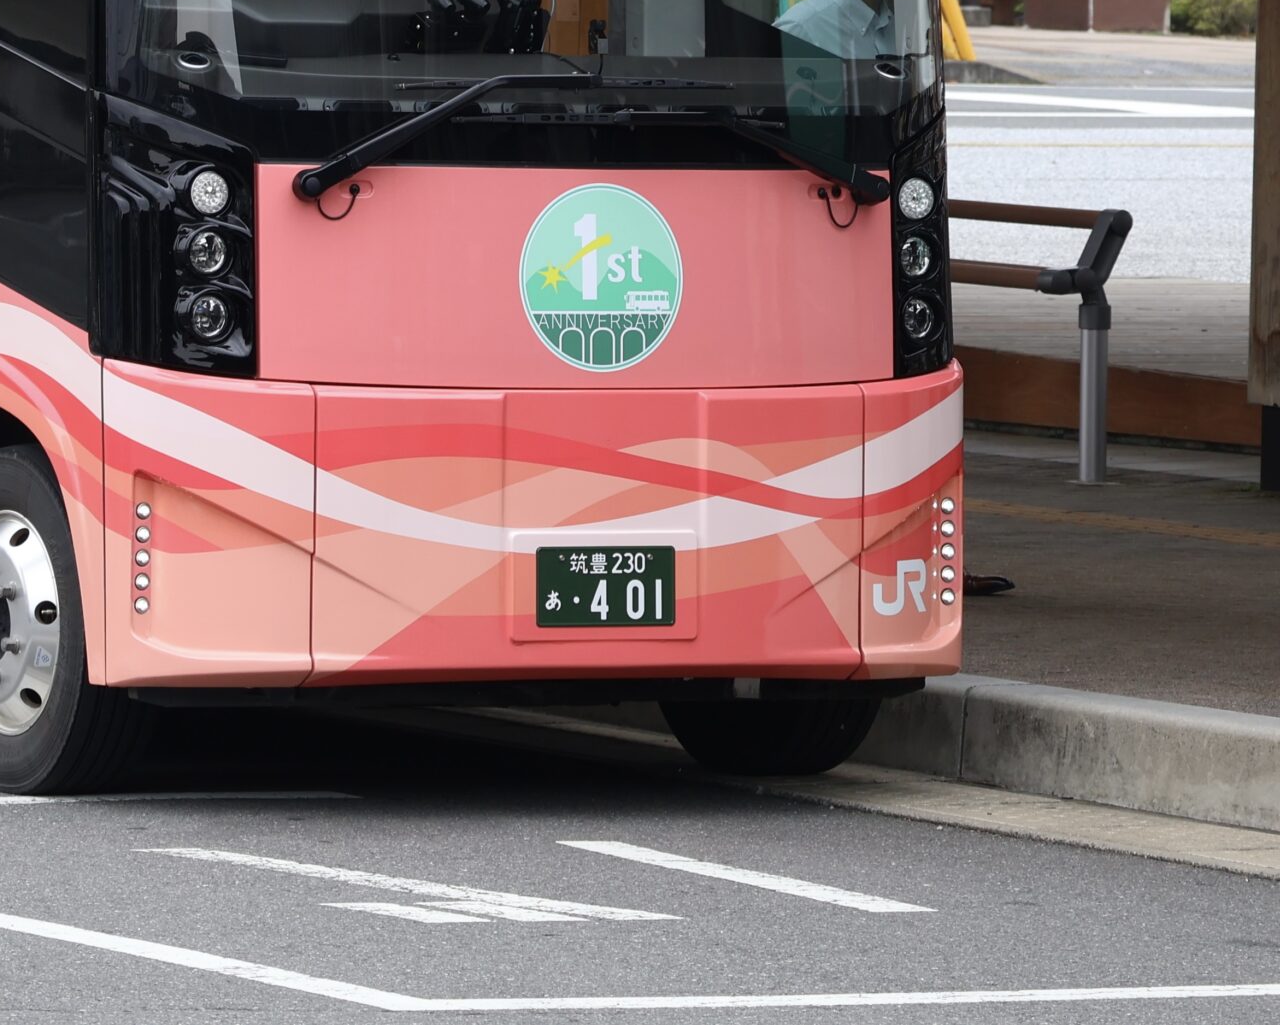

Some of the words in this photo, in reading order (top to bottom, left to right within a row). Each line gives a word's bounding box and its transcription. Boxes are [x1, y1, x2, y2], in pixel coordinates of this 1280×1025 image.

[574, 213, 644, 301] 1st
[537, 312, 670, 330] ANNIVERSARY
[569, 552, 608, 574] 筑豊
[611, 552, 646, 574] 230
[872, 558, 927, 616] JR
